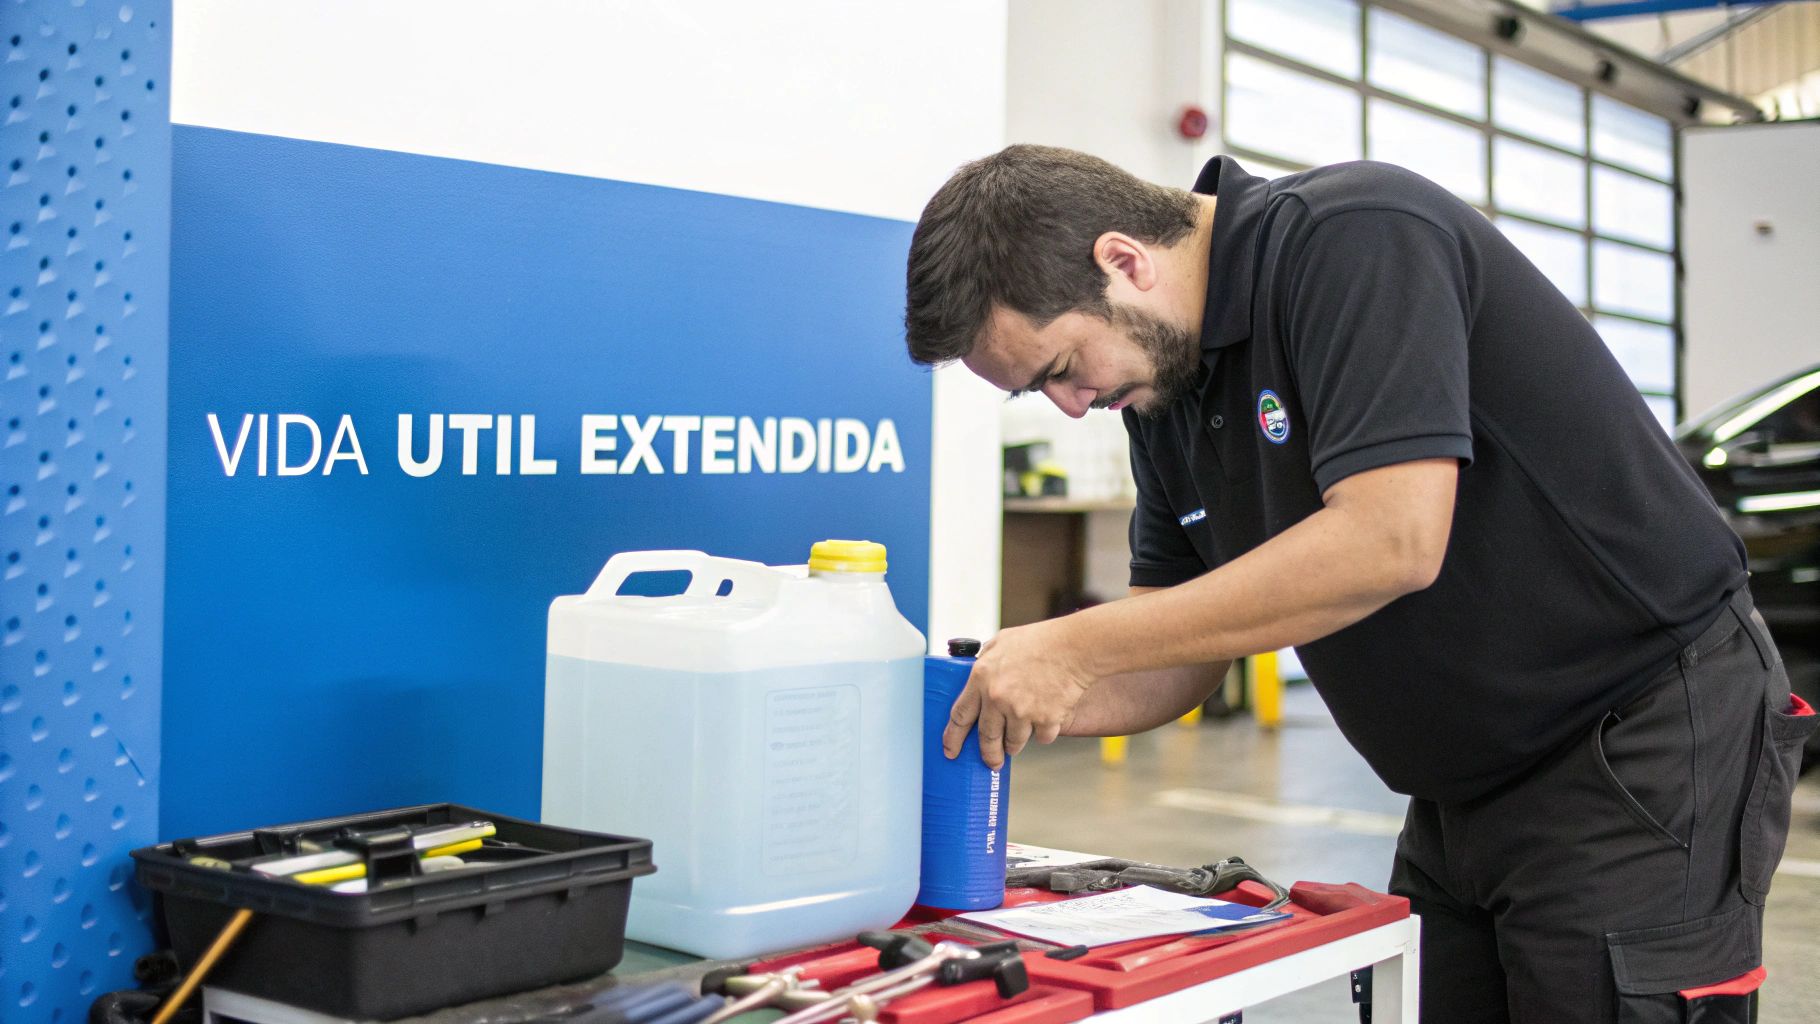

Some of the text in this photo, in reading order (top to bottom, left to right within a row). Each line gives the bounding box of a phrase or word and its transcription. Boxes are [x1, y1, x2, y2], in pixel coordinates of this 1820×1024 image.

[207, 413, 906, 478] VIDA UTIL EXTENDIDA
